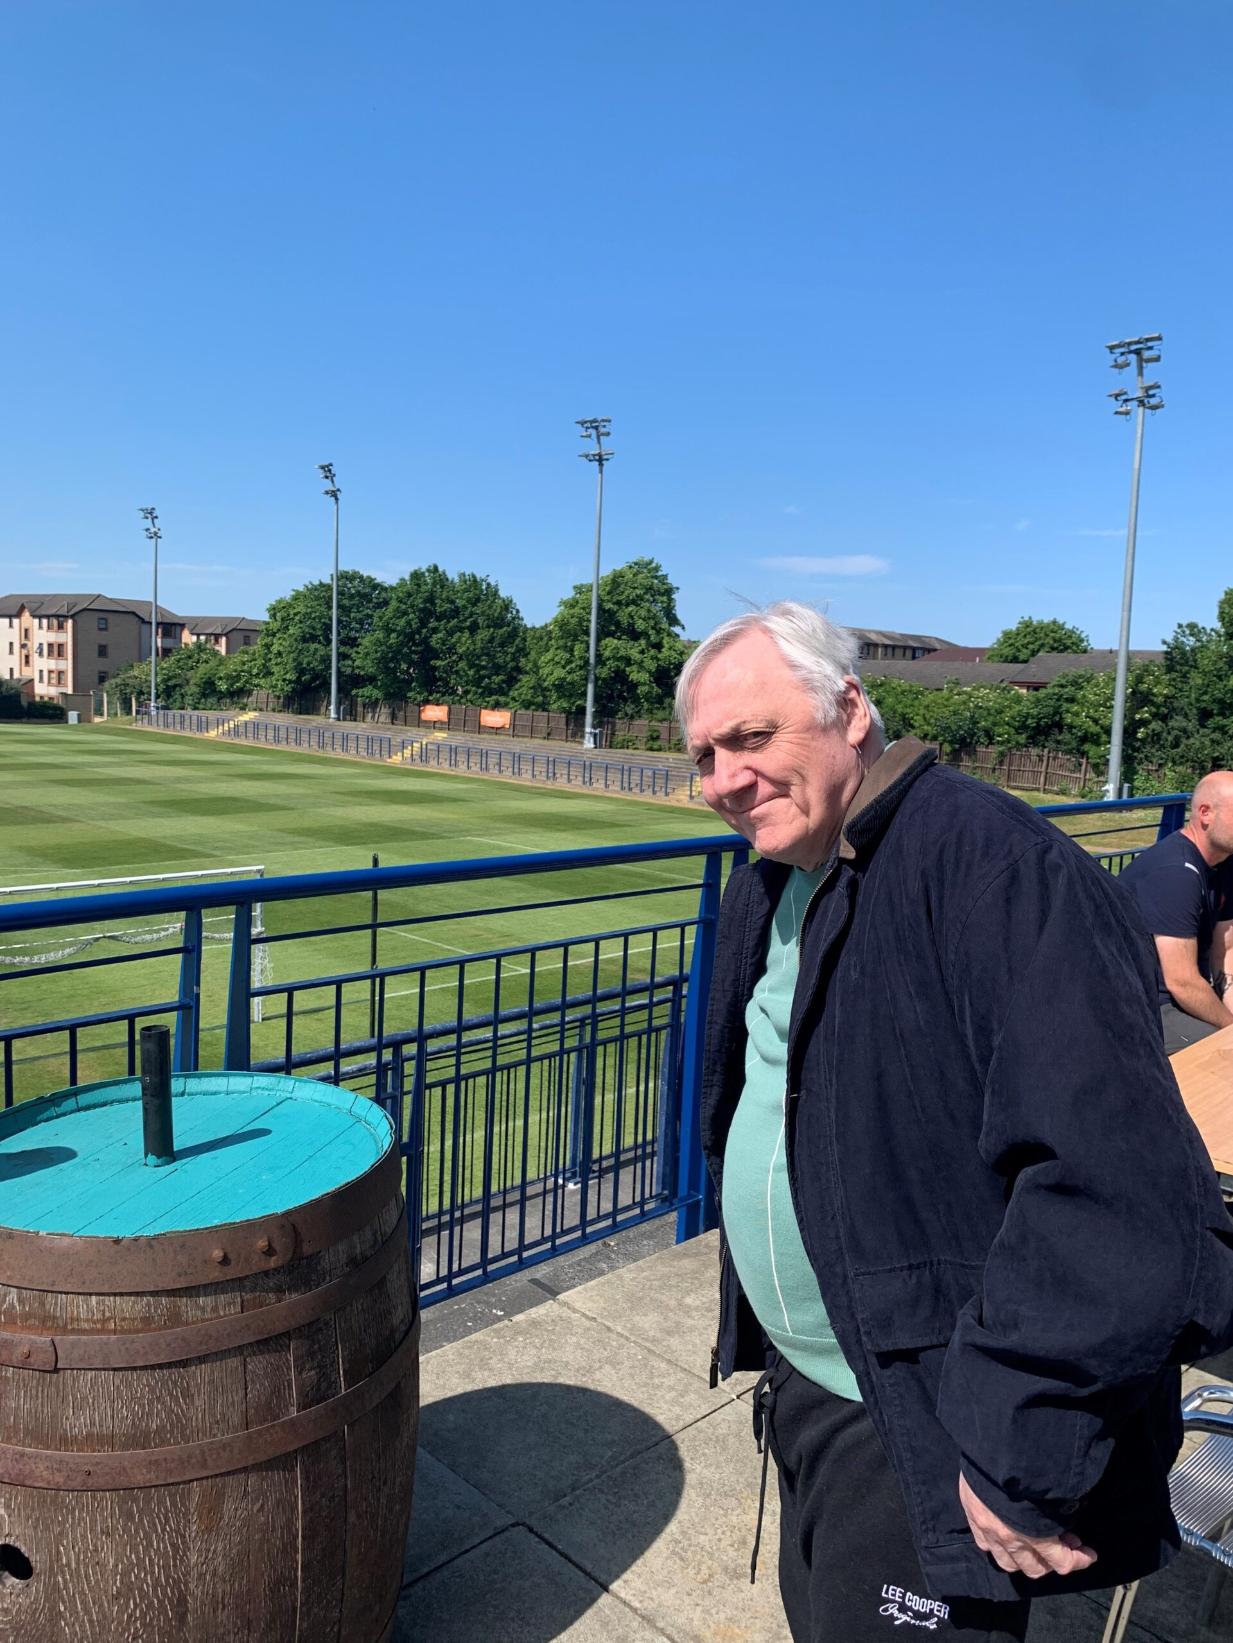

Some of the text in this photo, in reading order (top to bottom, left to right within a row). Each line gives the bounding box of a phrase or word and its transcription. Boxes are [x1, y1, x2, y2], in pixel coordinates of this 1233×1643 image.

[879, 1603, 937, 1629] Originals
[881, 1584, 949, 1619] LEE COOPER
